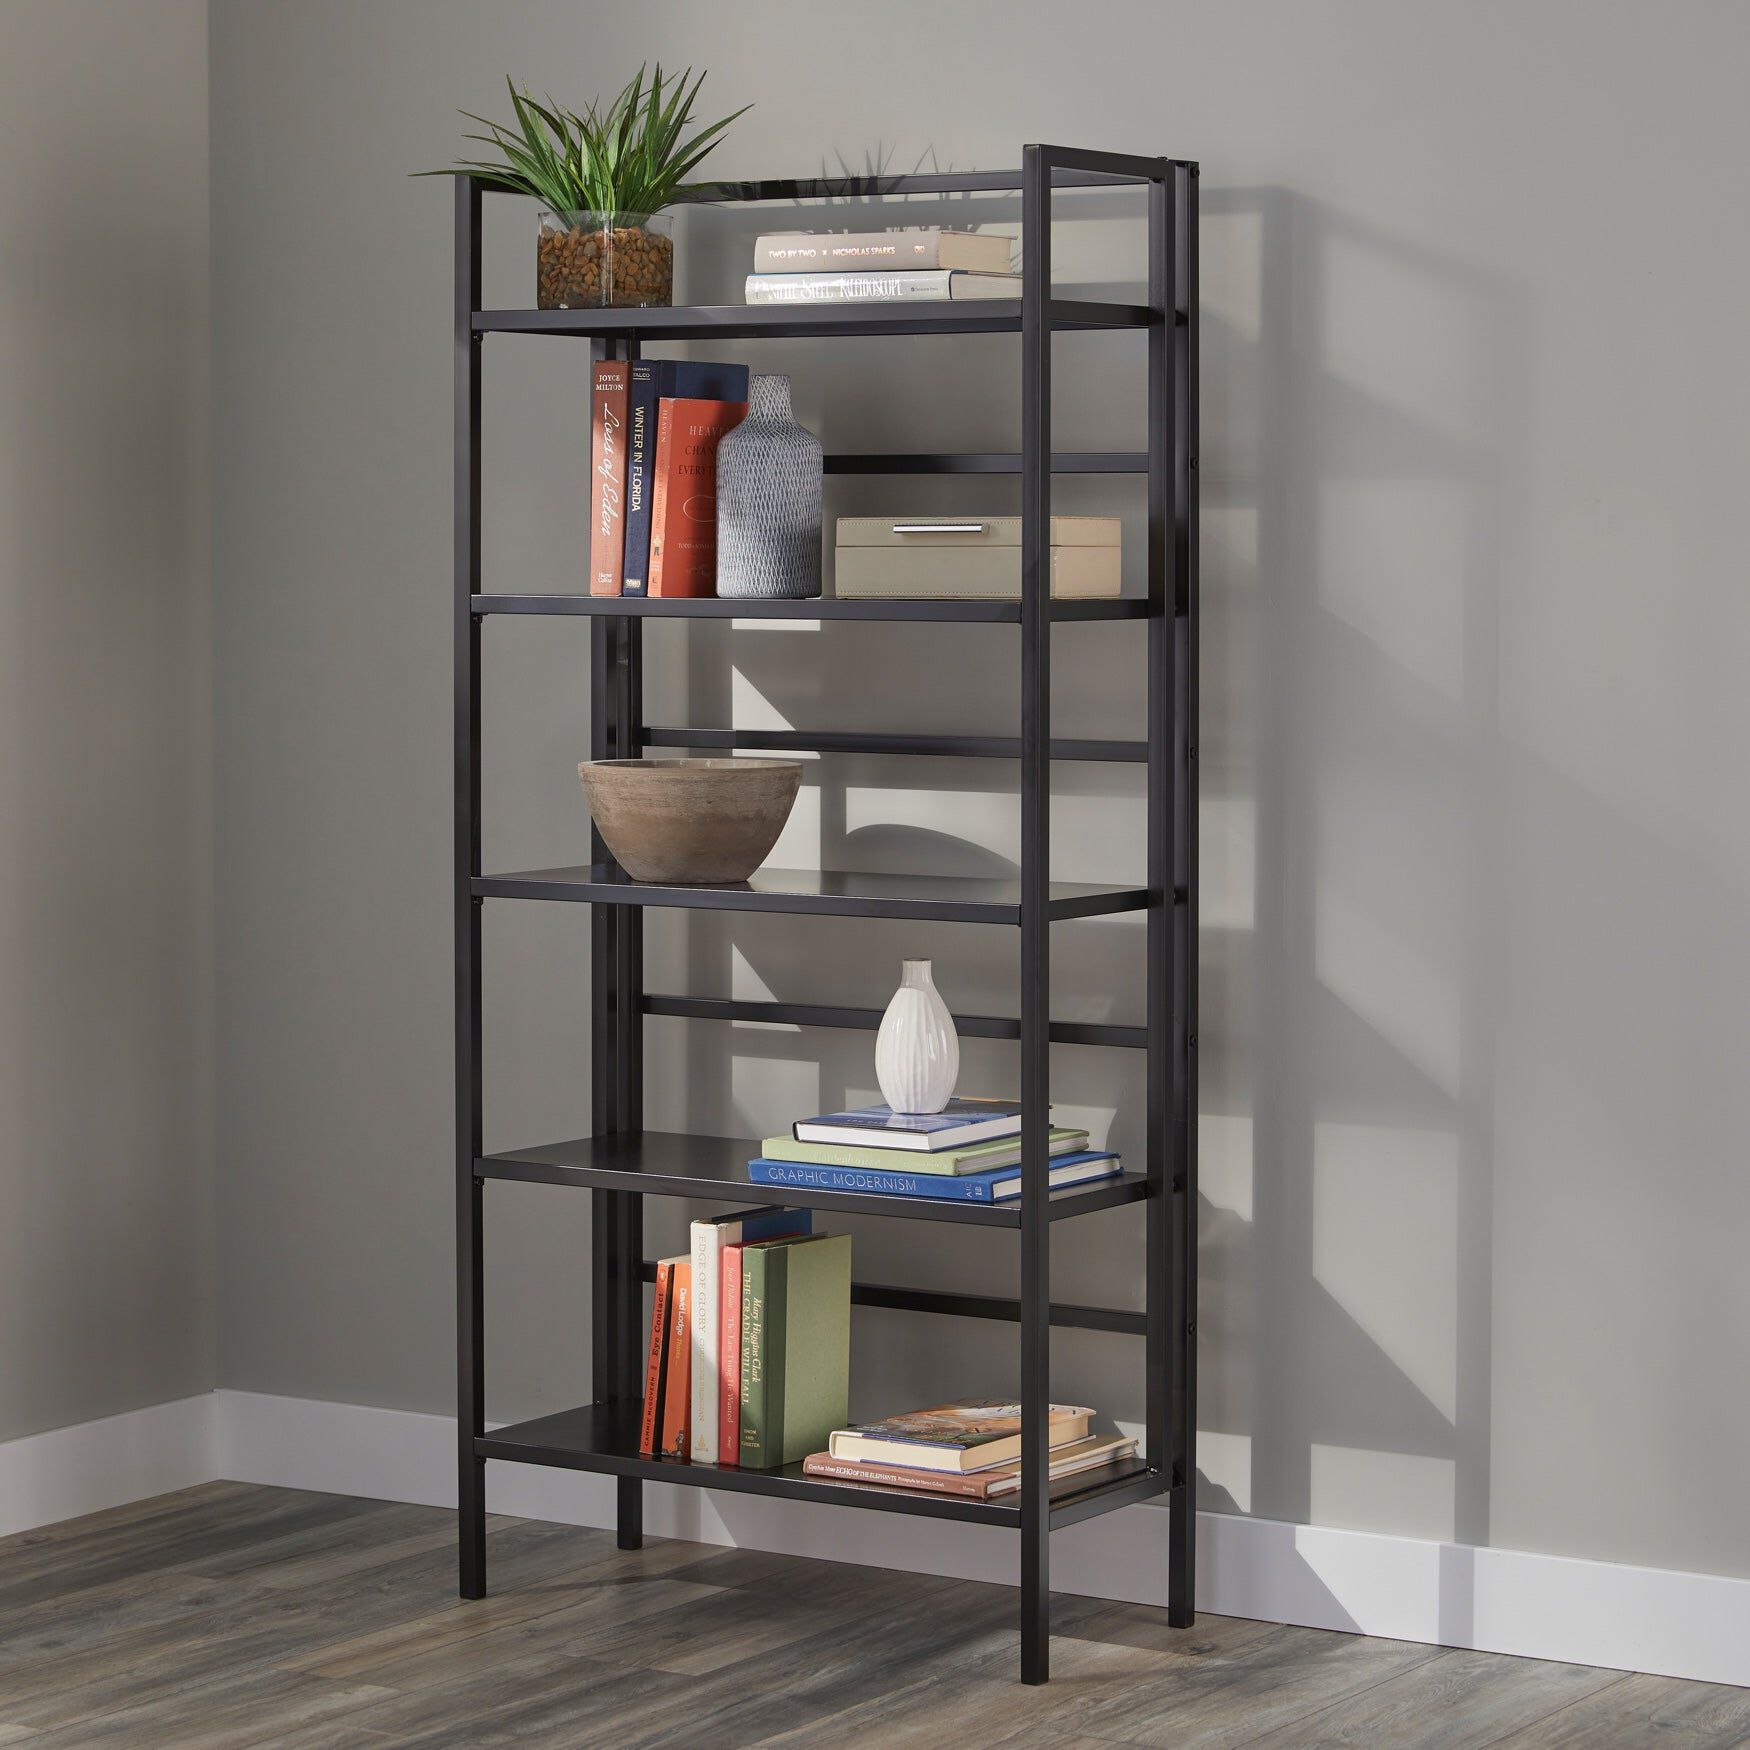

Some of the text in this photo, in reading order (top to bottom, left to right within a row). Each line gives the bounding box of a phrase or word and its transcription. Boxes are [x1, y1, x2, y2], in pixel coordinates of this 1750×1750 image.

[768, 249, 817, 259] TWO BY TWO
[832, 246, 896, 257] NICHOLAS SPARKS
[599, 374, 621, 382] JOYCE
[597, 458, 620, 484] of
[631, 406, 645, 512] WINTER IN FLORIDA
[601, 483, 619, 536] Eden
[768, 1167, 917, 1191] GRAPHIC MODERNISM
[698, 1236, 706, 1269] EDGE
[698, 1272, 706, 1286] OF
[679, 1287, 688, 1313] David
[698, 1291, 706, 1333] GLORY
[652, 1293, 664, 1356] Eye Contact
[675, 1311, 685, 1336] Lodge
[727, 1316, 735, 1333] The
[741, 1272, 751, 1405] THE CRADLE WILL FALL
[750, 1297, 762, 1383] Mary Higgins Clark
[836, 1466, 853, 1475] ECHO
[869, 1472, 897, 1482] ELEPHANTS
